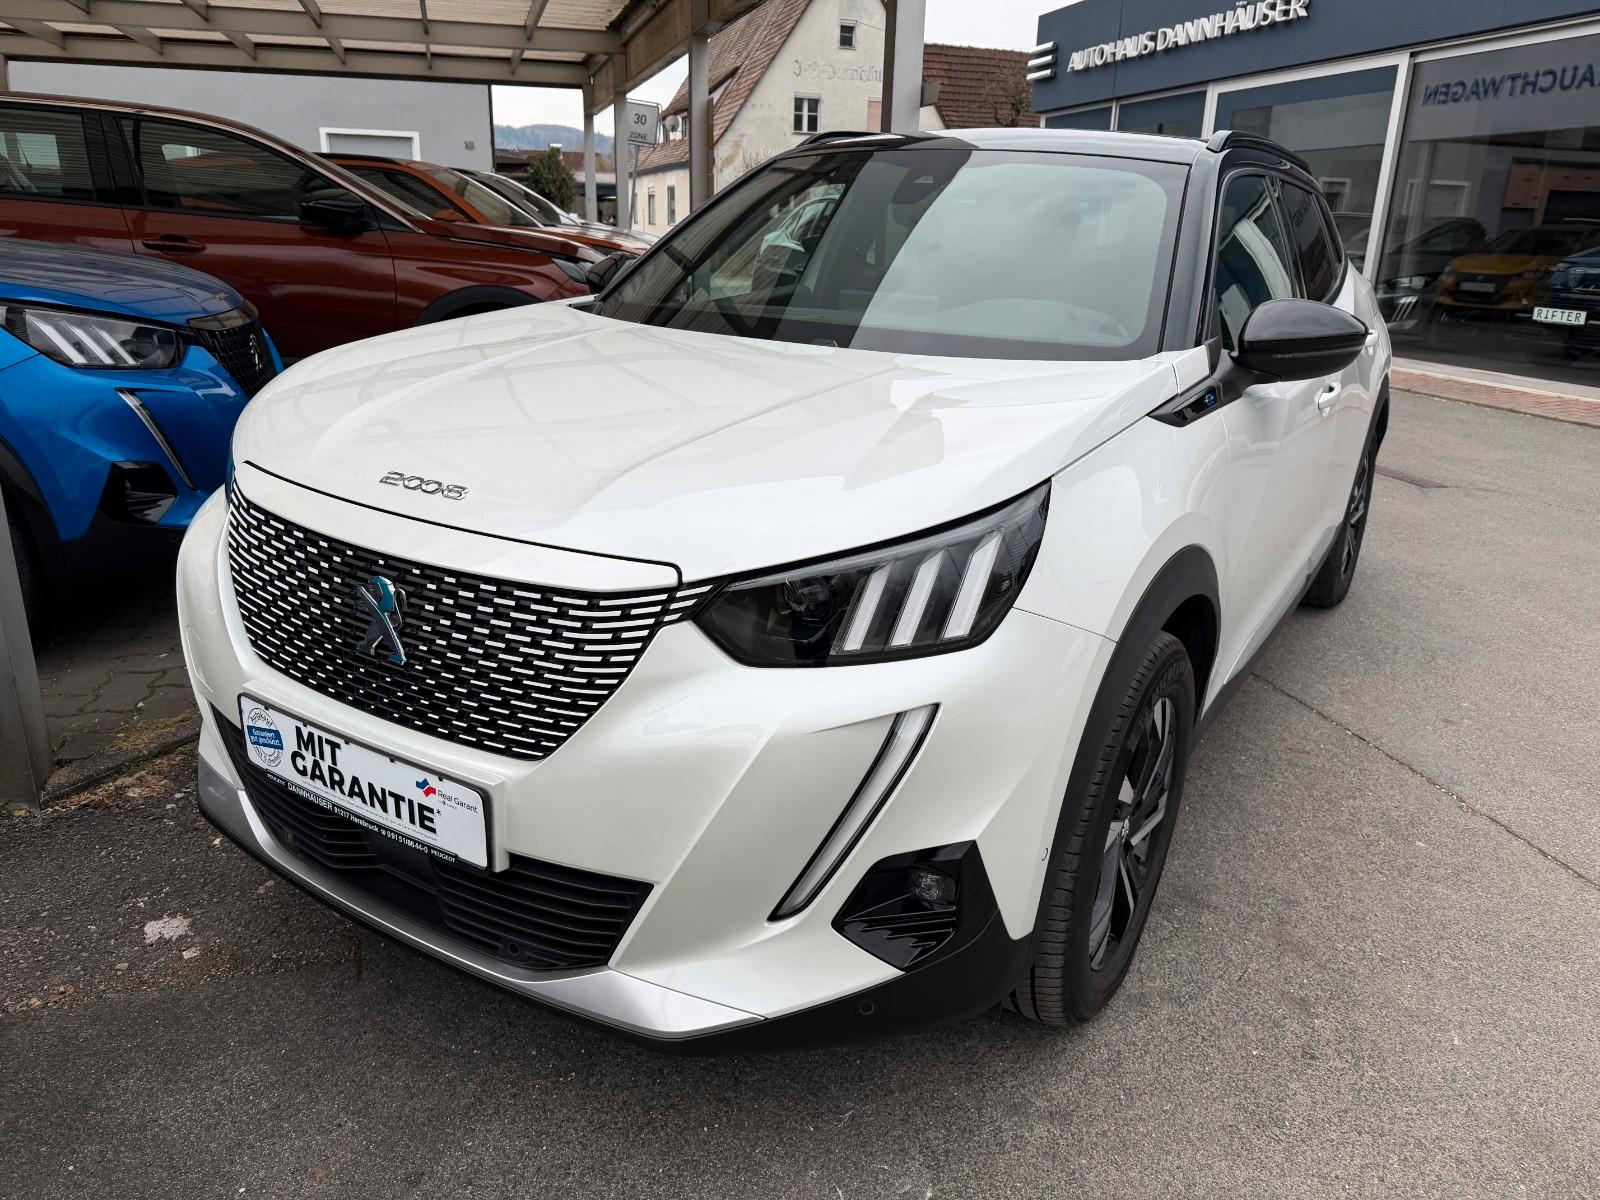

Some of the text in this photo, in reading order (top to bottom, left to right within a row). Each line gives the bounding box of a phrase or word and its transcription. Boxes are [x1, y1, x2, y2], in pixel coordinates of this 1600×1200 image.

[1067, 0, 1309, 73] AUTOHAUS DANNHÄUSER
[634, 113, 647, 125] 30
[630, 131, 648, 140] ZONE
[1536, 308, 1582, 323] RIFTER
[379, 471, 469, 500] 2008
[295, 725, 341, 766] MIT
[438, 790, 453, 802] Real
[454, 798, 478, 814] Garant
[333, 806, 349, 819] 91217
[350, 813, 379, 833] Hersbruck
[430, 848, 456, 863] PEUGEOT
